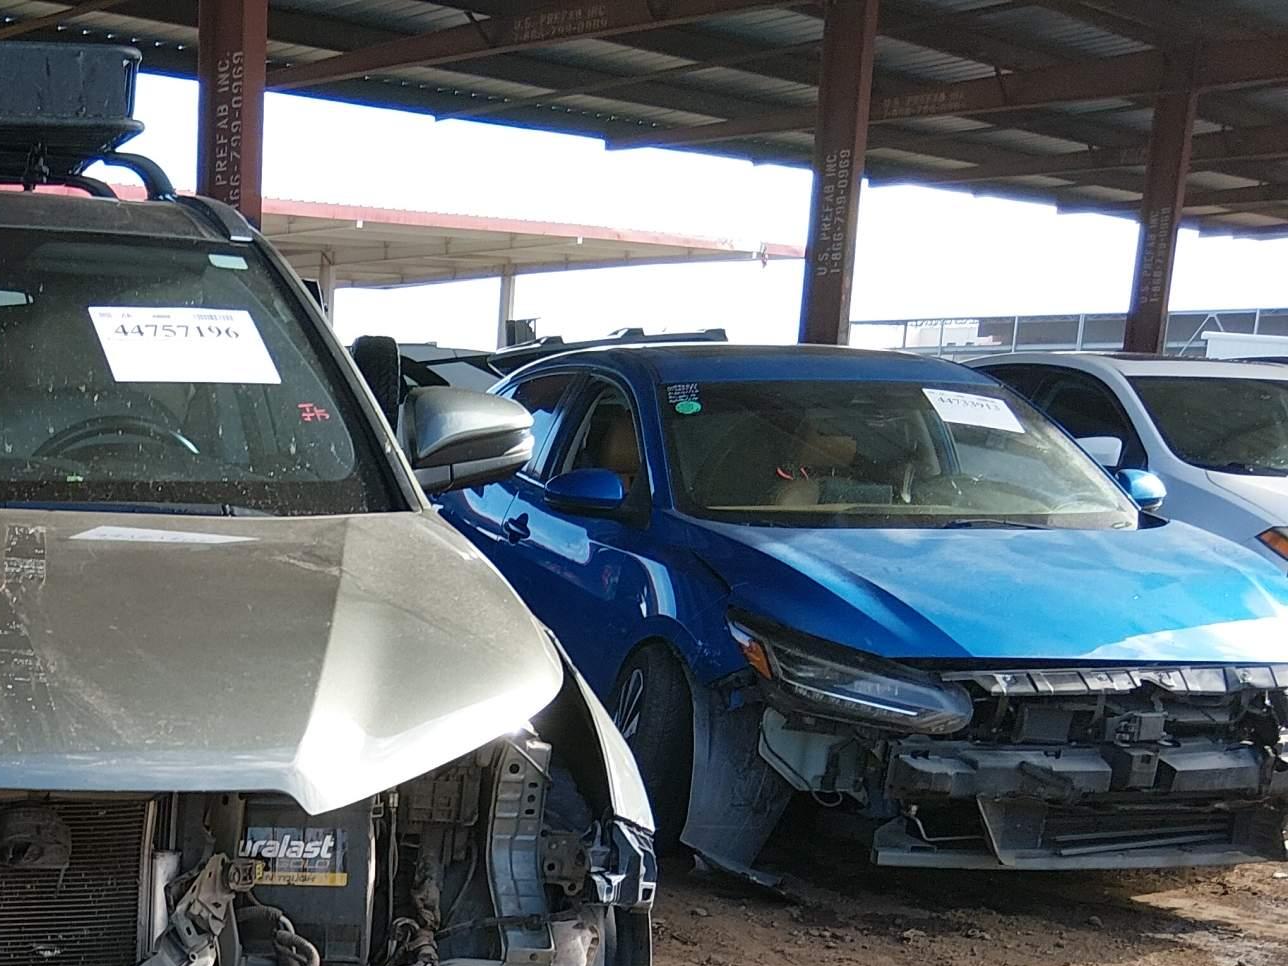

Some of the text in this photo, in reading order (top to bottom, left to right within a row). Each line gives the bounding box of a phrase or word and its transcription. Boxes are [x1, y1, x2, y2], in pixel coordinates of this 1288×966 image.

[215, 103, 229, 186] PREFAB
[820, 184, 834, 241] PREFAB
[816, 247, 831, 276] U.S.
[114, 324, 240, 339] 44757196
